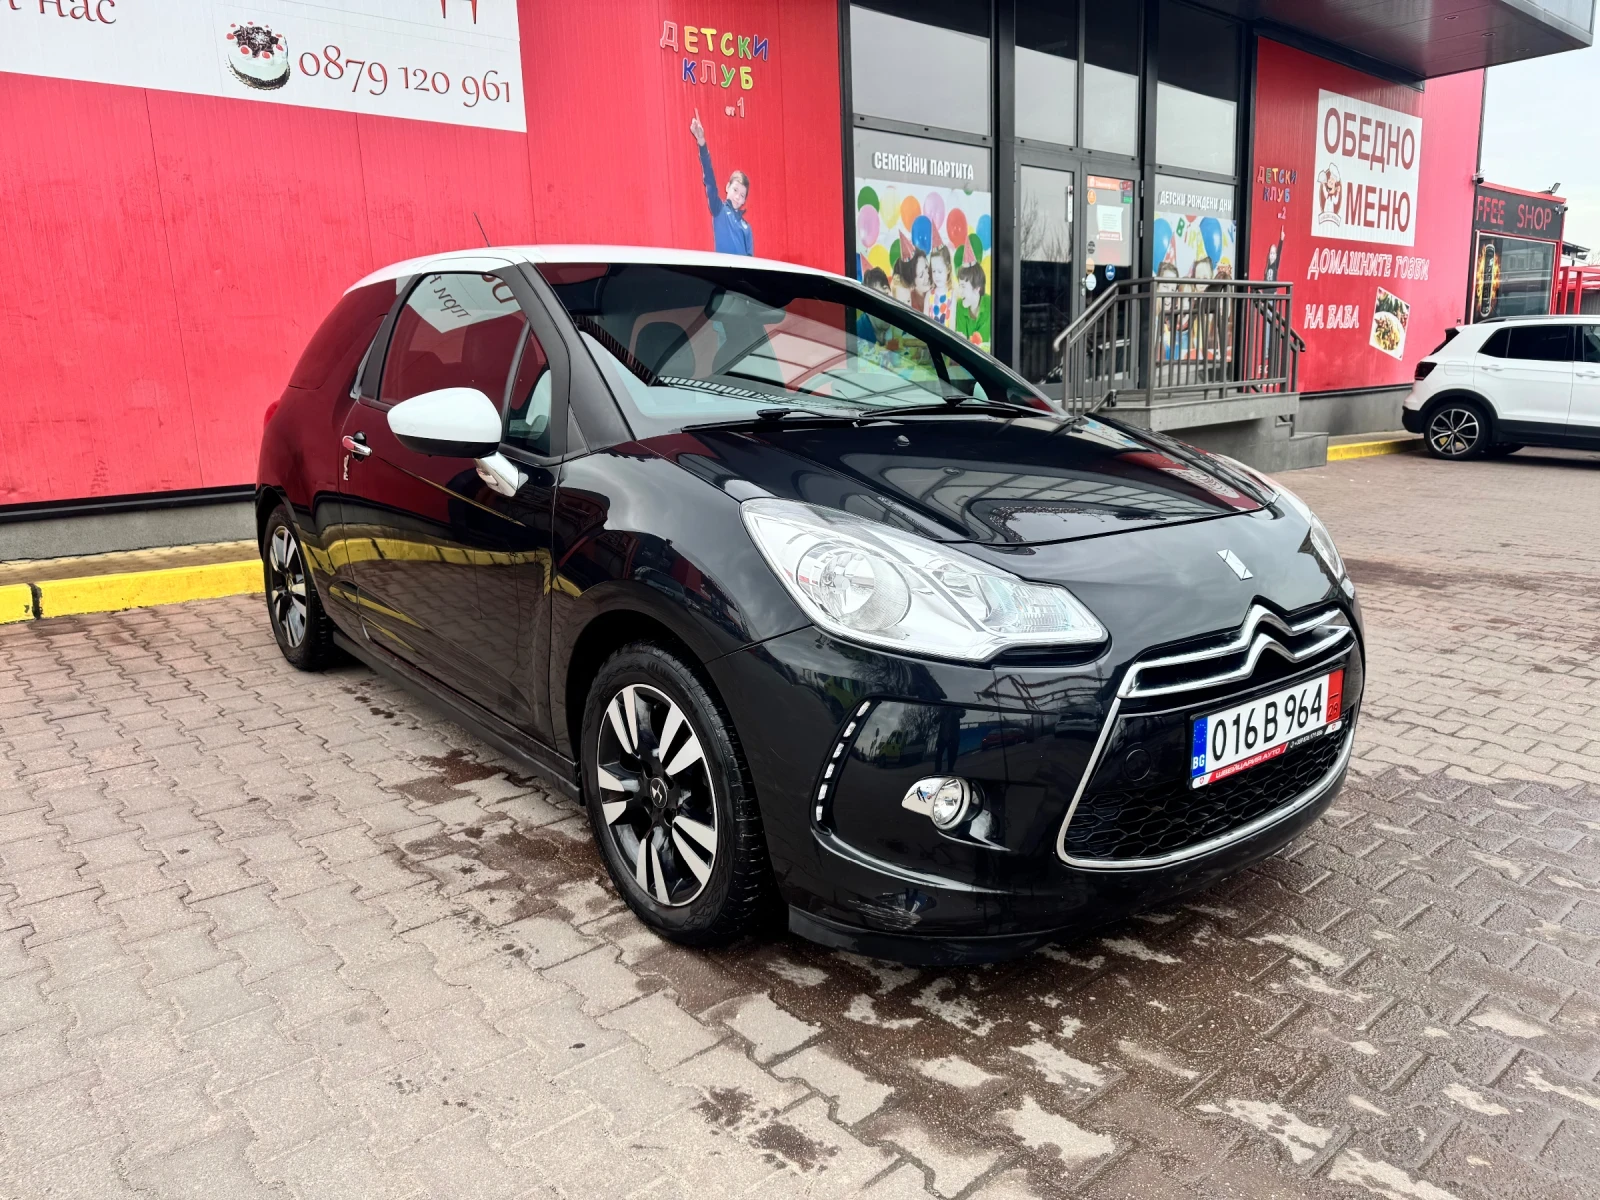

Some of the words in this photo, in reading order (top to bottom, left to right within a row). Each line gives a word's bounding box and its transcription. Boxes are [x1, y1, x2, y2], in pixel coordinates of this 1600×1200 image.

[660, 20, 769, 61] ДЕТСКИ
[299, 45, 388, 95] 0879
[398, 66, 450, 94] 120
[461, 70, 510, 107] 961
[682, 57, 753, 90] КЛУБ
[1324, 107, 1415, 173] ОБЕДНО
[874, 151, 927, 175] СЕМЕЙНИ
[930, 159, 974, 180] ПАРТИТА
[1256, 166, 1297, 185] ДЕТСКИ
[1160, 190, 1186, 205] ДЕТСКИ
[1187, 194, 1218, 211] РОЖДЕНИ
[1219, 198, 1232, 212] ДНИ
[1262, 186, 1290, 202] КЛУБ
[1345, 181, 1411, 232] МЕНЮ
[1517, 203, 1552, 231] SHOP
[1307, 247, 1392, 280] ДОМАШНИТЕ
[1394, 256, 1430, 280] ГОЗБИ
[1304, 304, 1324, 329] НА
[1326, 304, 1359, 329] БАБА
[1192, 754, 1205, 770] BG
